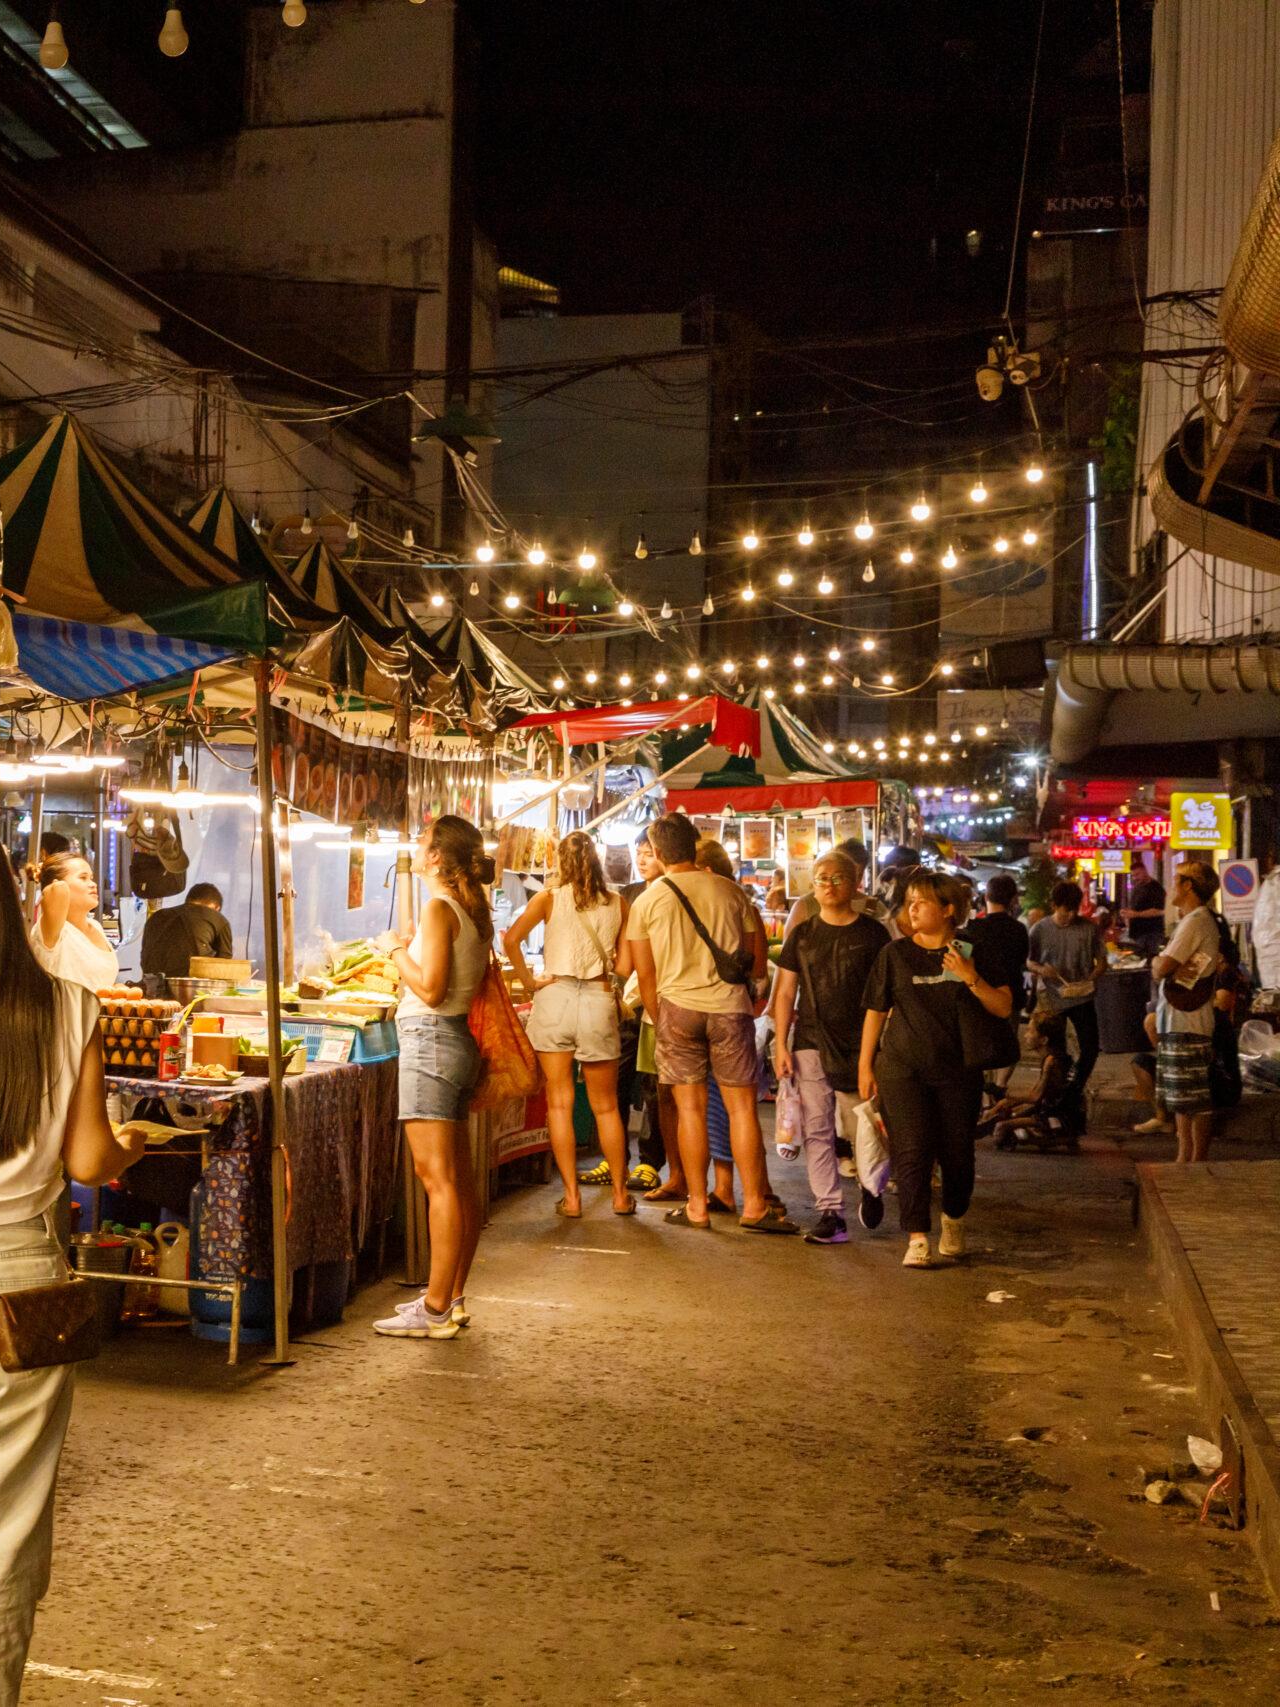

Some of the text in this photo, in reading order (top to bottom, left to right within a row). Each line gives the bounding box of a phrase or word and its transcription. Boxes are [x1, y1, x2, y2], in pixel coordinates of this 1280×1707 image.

[1046, 195, 1116, 212] KING'S
[1076, 821, 1124, 838] KING'S
[1179, 829, 1221, 840] SINGHA
